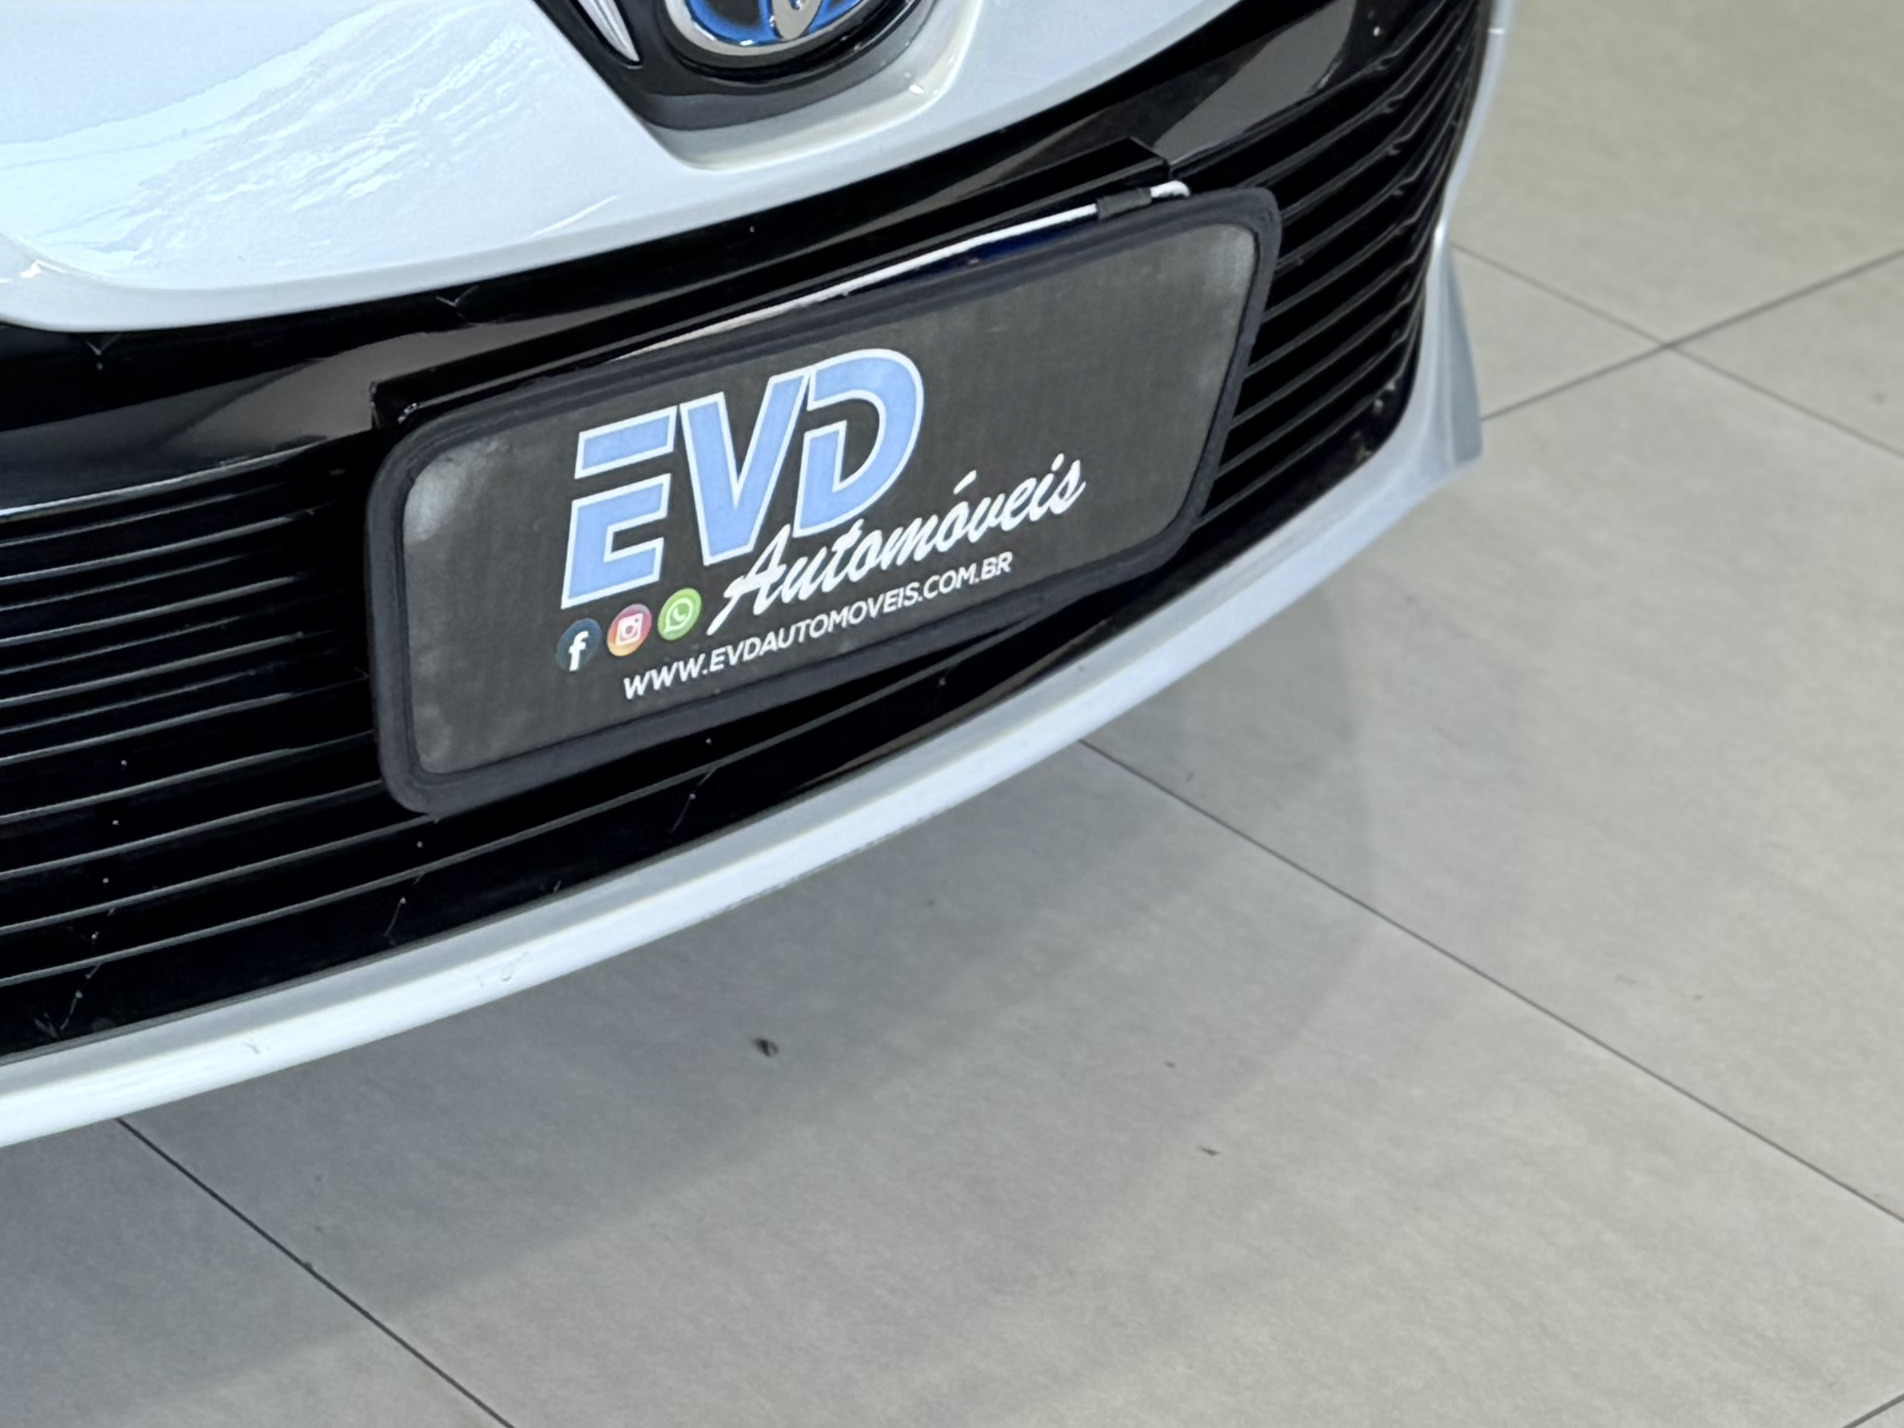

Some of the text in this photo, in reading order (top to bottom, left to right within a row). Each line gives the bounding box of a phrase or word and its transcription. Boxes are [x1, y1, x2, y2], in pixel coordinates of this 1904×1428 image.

[561, 348, 925, 610] EVD
[706, 453, 1087, 636] Automóveis
[622, 551, 1014, 700] WWW.EVDAUTOMOVEIS.COM.BR
